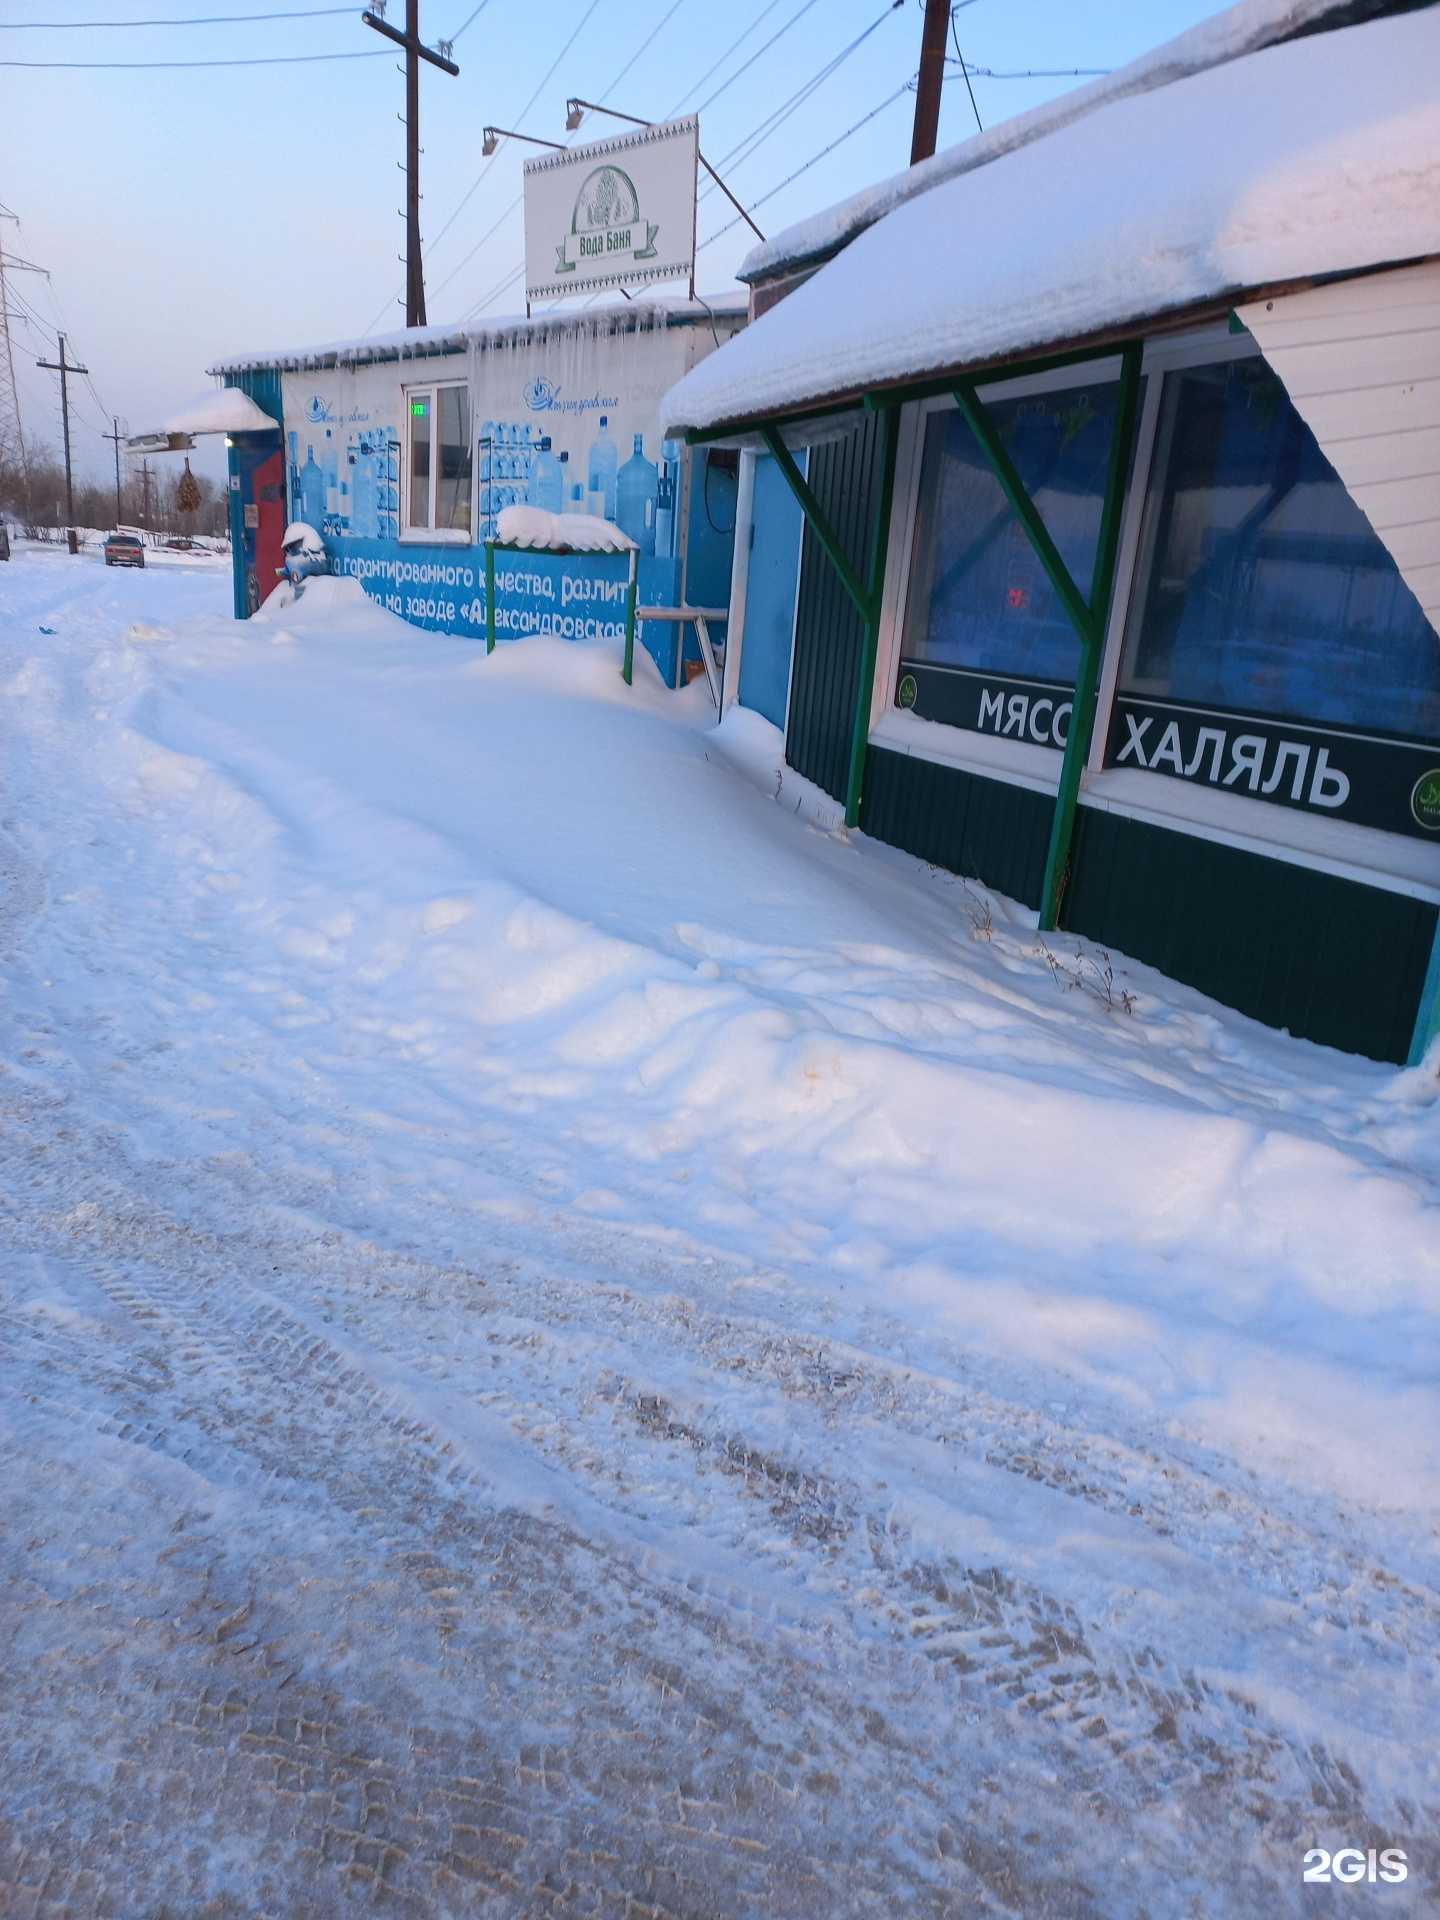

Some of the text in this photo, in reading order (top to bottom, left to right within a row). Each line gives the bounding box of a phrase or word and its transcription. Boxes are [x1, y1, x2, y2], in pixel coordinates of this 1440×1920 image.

[579, 229, 631, 257] Вода Баня
[343, 557, 474, 587] гарантированного
[478, 566, 556, 602] кчества,
[561, 575, 641, 607] разлит
[385, 593, 402, 615] на
[405, 596, 456, 622] заводе
[1116, 713, 1351, 809] ХАЛЯЛЬ
